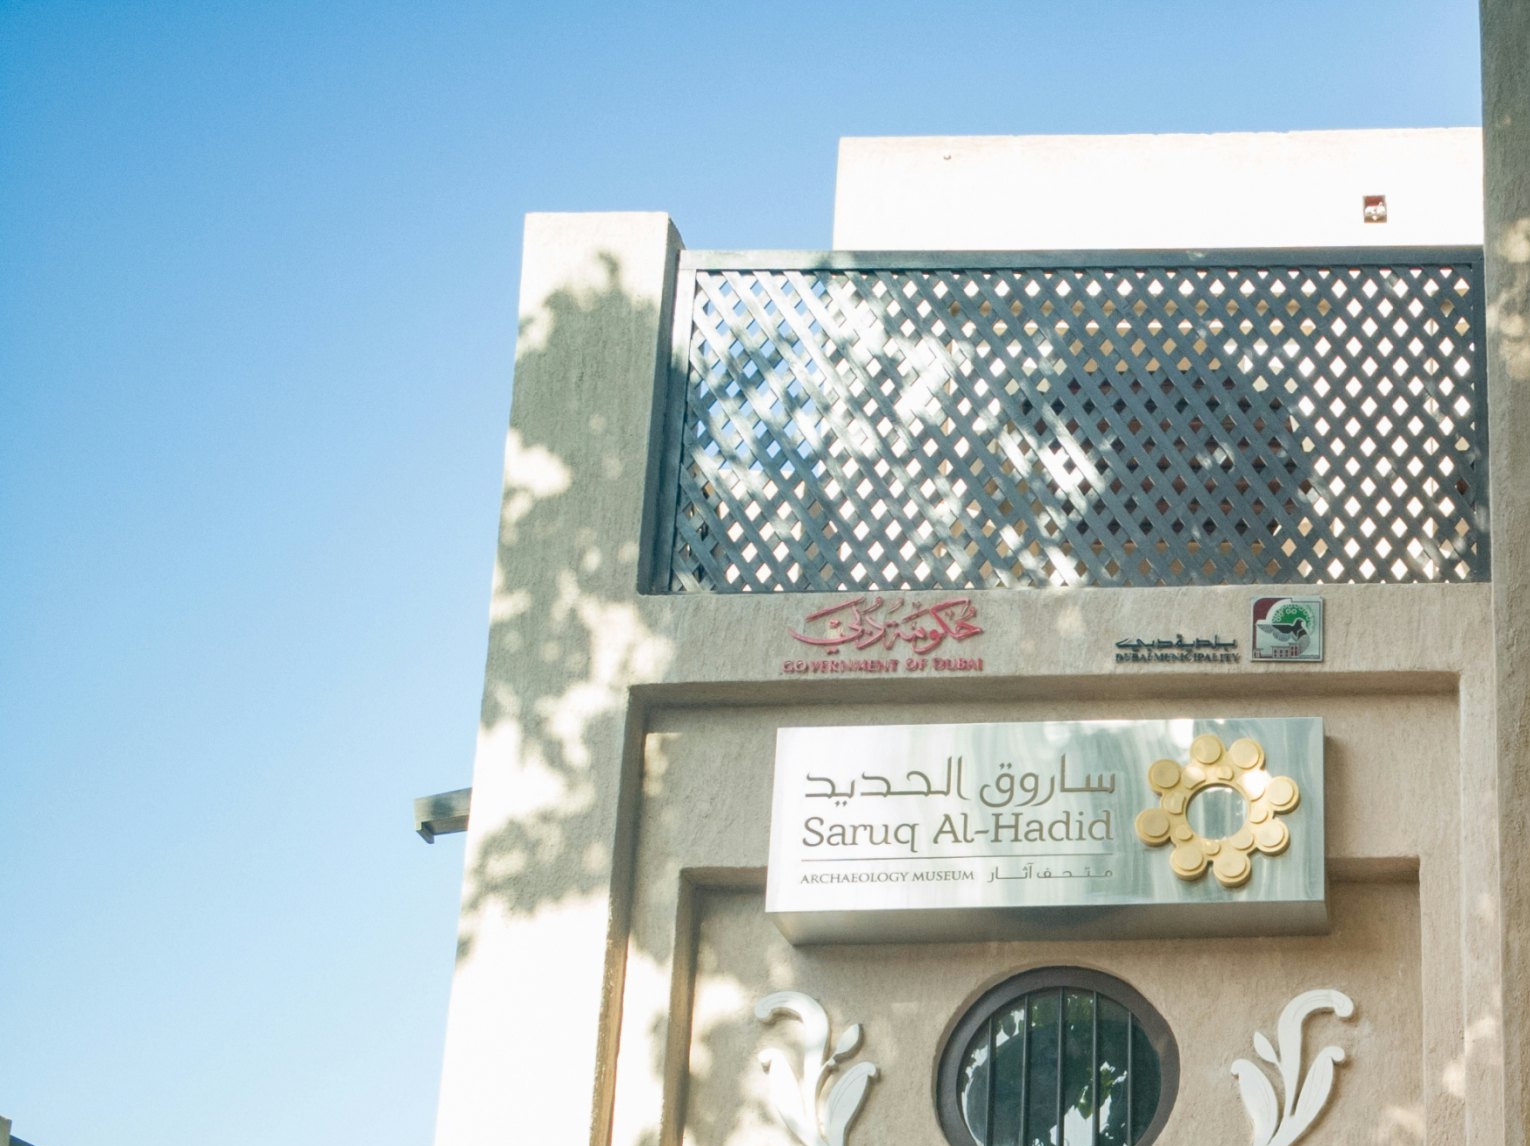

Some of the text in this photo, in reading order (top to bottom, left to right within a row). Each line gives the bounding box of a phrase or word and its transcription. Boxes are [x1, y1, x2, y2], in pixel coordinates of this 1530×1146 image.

[1115, 638, 1174, 653] دبي
[782, 656, 984, 674] GOVERNMENT OF DUBAI
[1115, 652, 1241, 663] DUBAI MUNICIPALITY
[804, 753, 1116, 808] ساروق الحديد
[801, 810, 1115, 853] Saruq Al-Hadid
[800, 869, 975, 885] ARCHAEOLOGY MUSEUM
[987, 862, 1113, 883] متحف آثار
